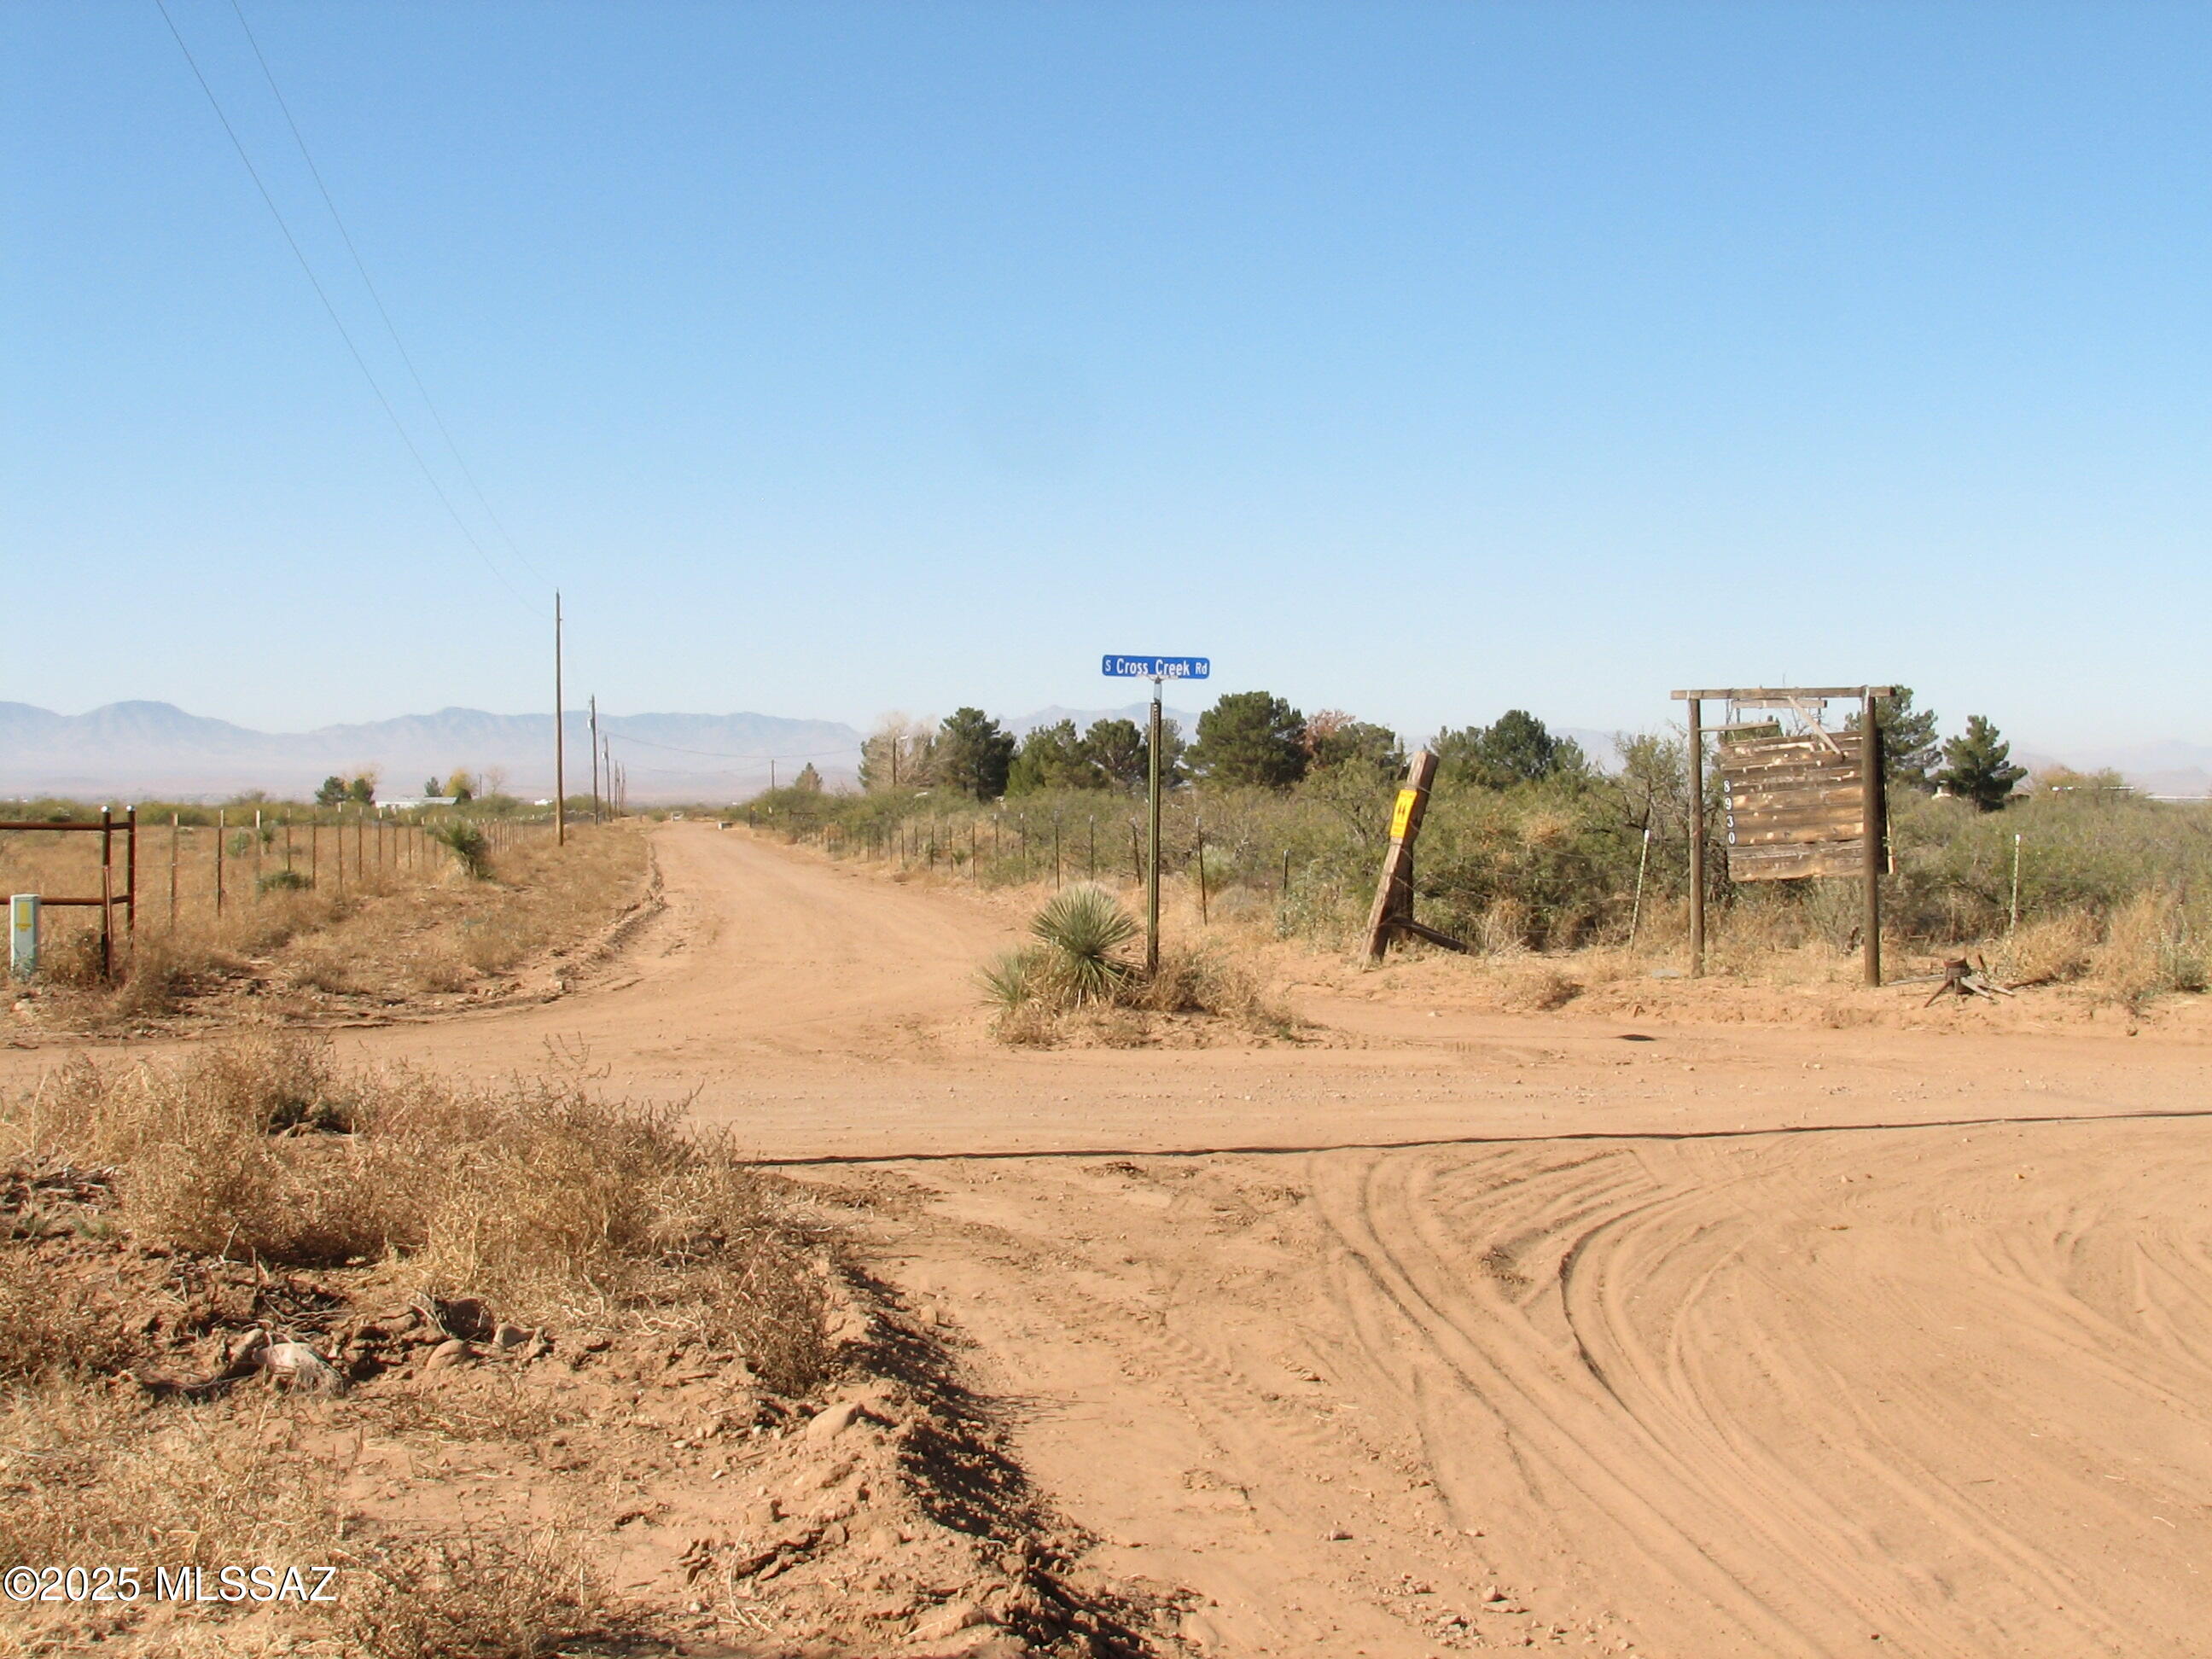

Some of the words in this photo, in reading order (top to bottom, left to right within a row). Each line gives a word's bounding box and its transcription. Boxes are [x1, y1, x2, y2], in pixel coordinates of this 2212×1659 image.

[1105, 659, 1112, 672] S
[1116, 658, 1149, 674] Cross
[1155, 659, 1190, 676] Creek
[1195, 661, 1208, 675] Rd
